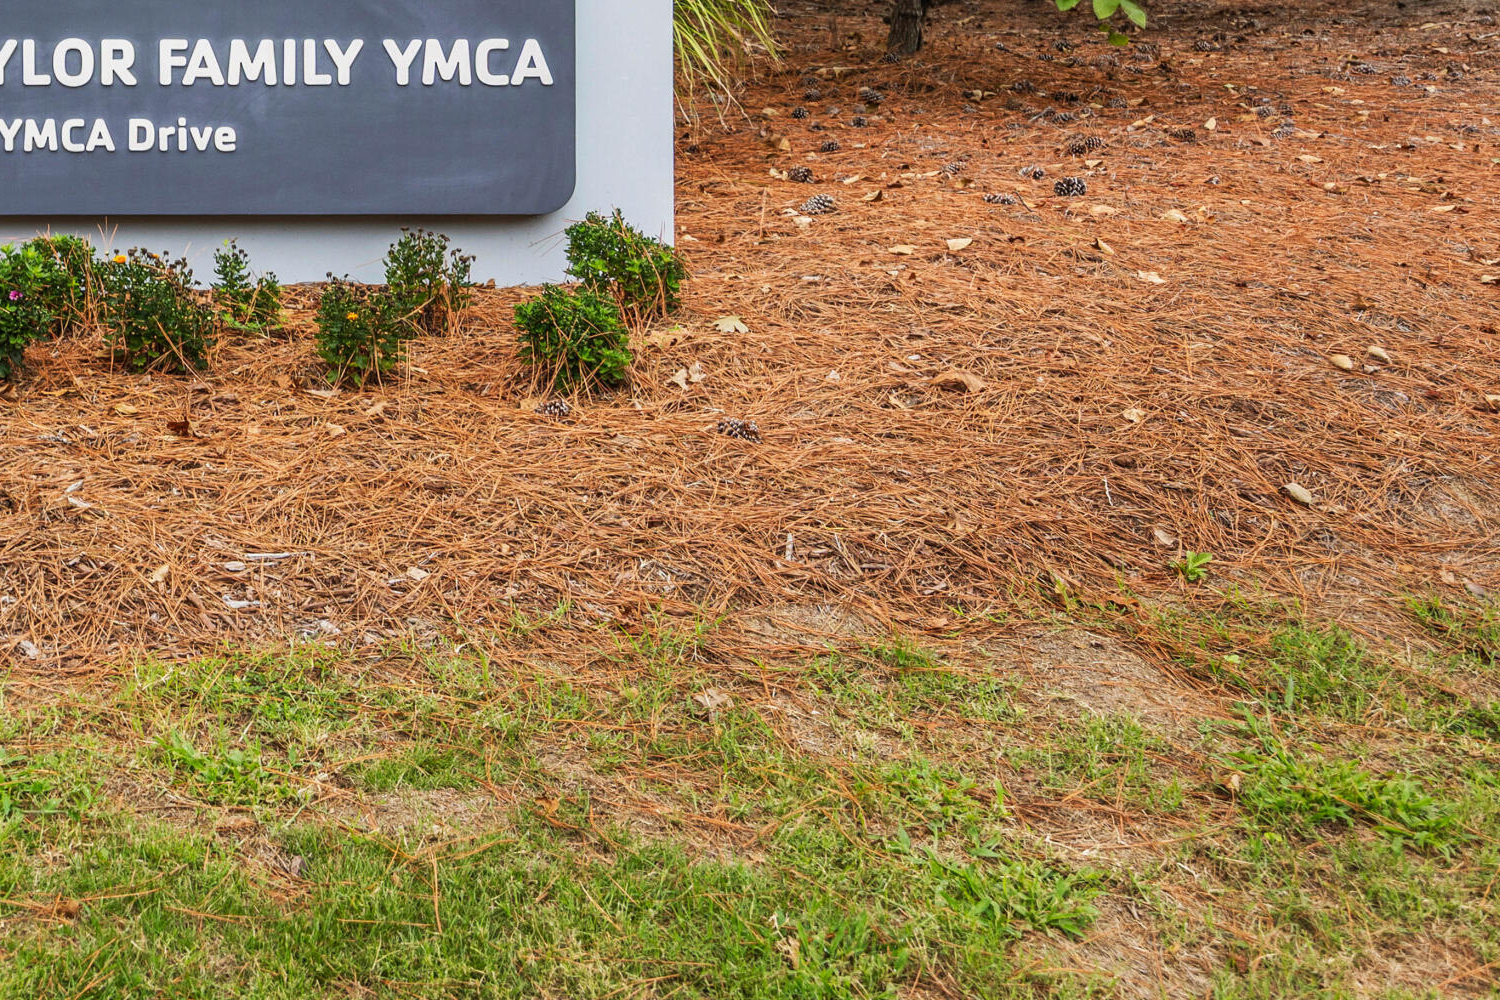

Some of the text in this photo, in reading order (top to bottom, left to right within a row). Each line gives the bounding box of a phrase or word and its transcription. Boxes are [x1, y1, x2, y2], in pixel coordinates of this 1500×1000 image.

[158, 38, 364, 87] FAMILY
[382, 38, 554, 86] YMCA
[128, 117, 238, 153] Drive
